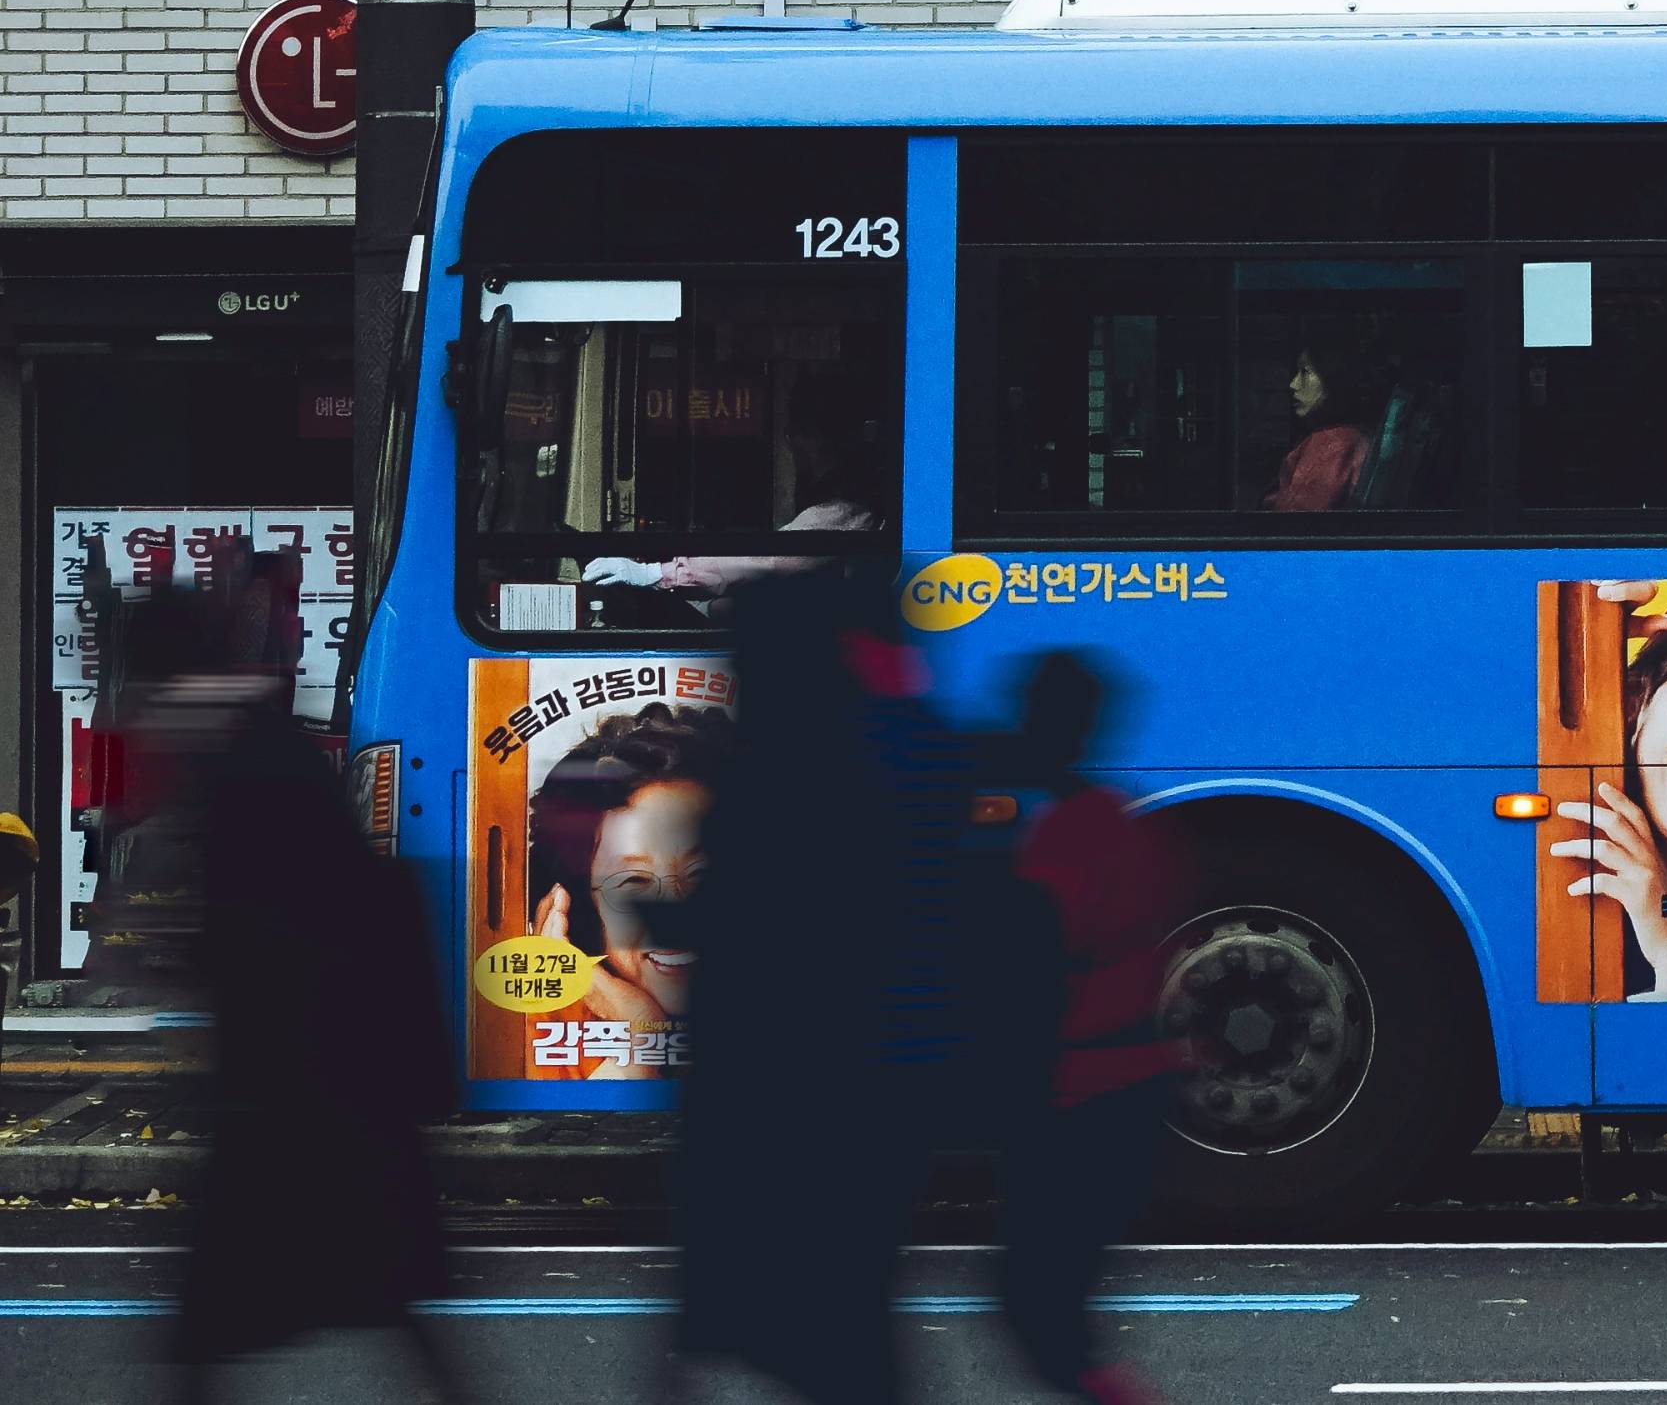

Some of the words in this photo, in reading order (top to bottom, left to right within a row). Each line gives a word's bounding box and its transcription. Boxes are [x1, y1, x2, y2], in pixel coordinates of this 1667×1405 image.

[795, 217, 901, 259] 1243
[911, 579, 992, 605] CNG
[1005, 562, 1229, 604] 천연가스버스
[482, 688, 571, 765] 웃음과
[572, 666, 667, 710] 감동의
[487, 953, 529, 974] 11월
[533, 953, 578, 974] 27일
[504, 977, 564, 999] 대개봉
